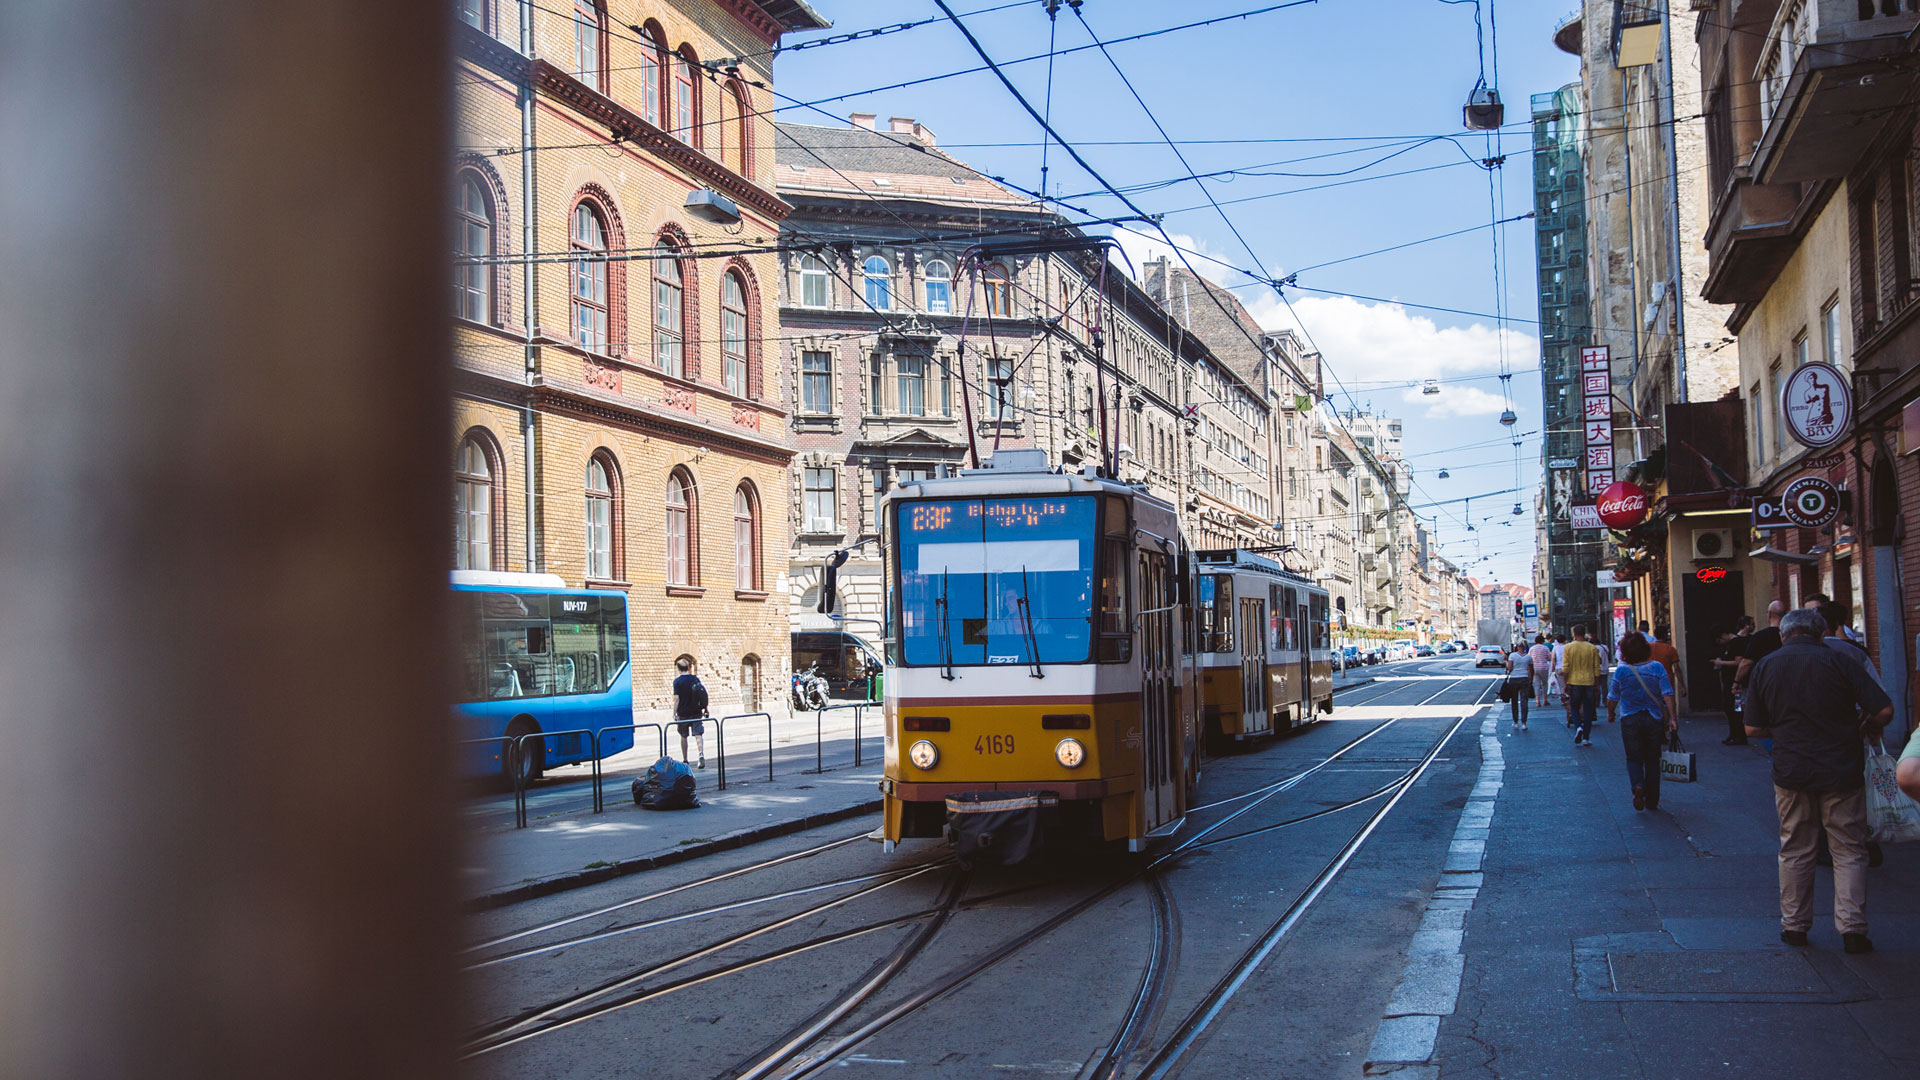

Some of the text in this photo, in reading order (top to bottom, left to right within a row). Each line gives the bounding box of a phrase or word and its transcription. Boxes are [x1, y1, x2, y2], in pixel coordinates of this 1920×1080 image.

[1791, 480, 1830, 493] NEMZETI
[1573, 506, 1597, 517] CHIN
[1574, 517, 1605, 528] RESTA
[1696, 568, 1727, 582] Open
[974, 734, 1015, 755] 4169
